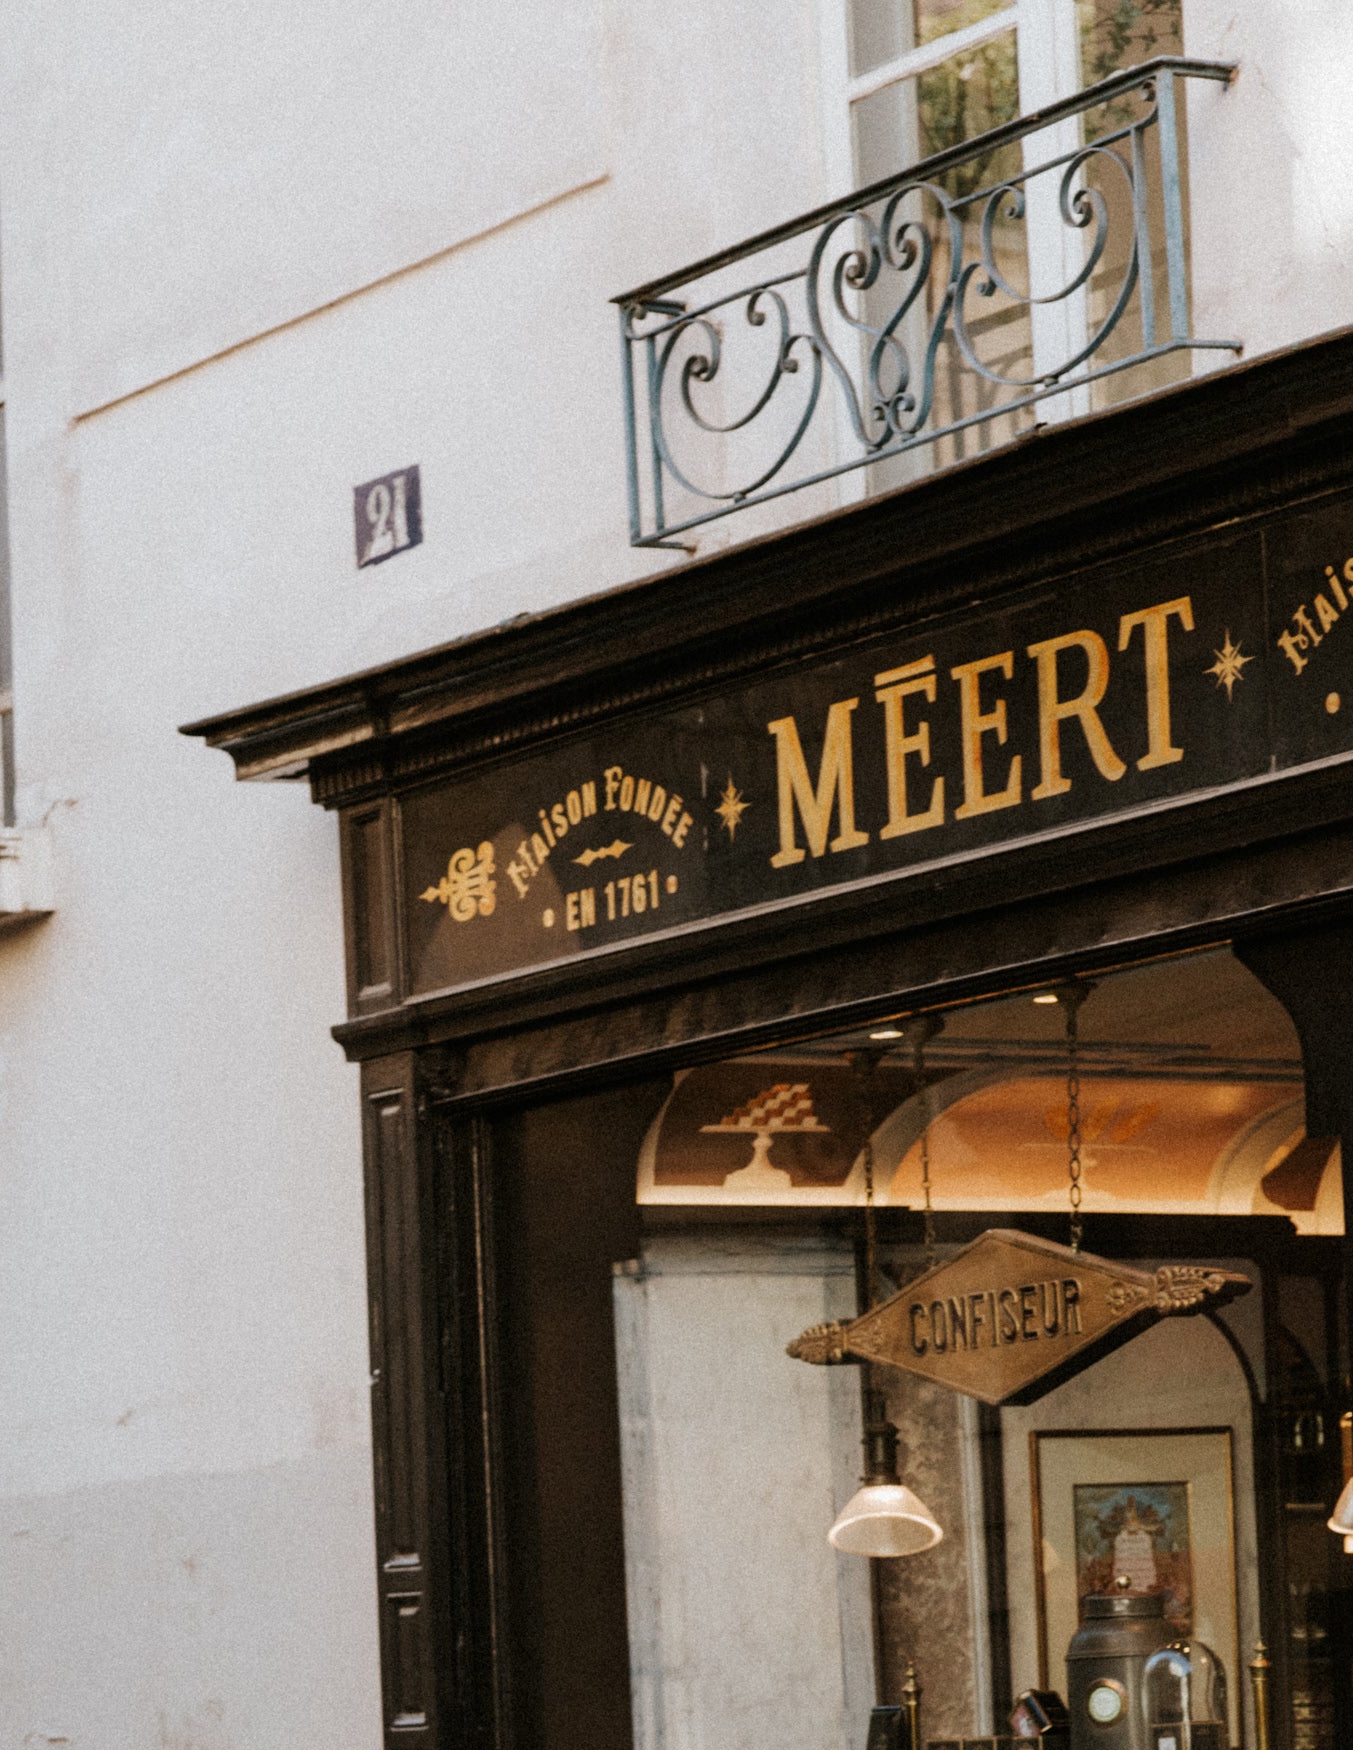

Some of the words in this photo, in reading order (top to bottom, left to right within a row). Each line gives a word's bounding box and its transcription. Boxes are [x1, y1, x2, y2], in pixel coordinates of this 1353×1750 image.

[364, 476, 411, 559] 21
[565, 887, 596, 932] EN
[604, 869, 659, 921] 1761
[909, 1278, 1083, 1358] CONFISEUR
